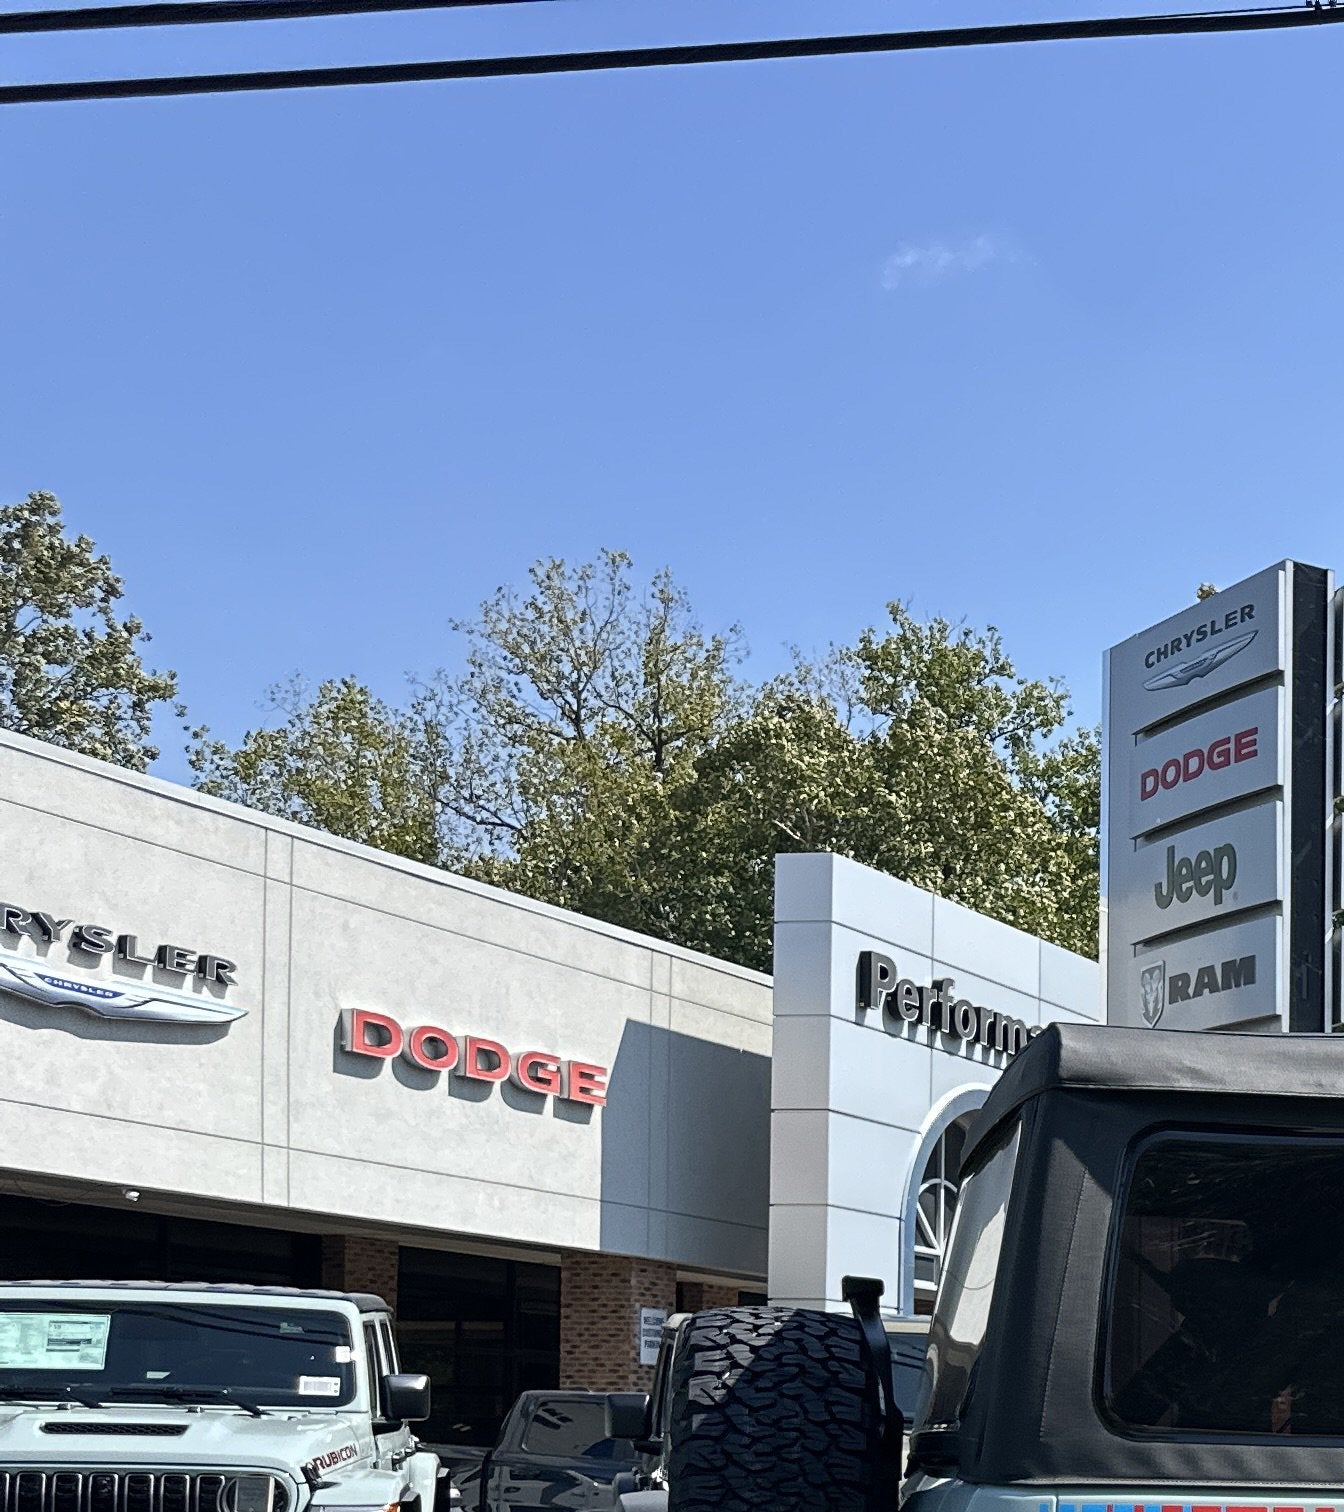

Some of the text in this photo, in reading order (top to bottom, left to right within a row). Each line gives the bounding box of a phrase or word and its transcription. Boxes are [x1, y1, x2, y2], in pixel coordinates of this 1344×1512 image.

[1144, 604, 1255, 669] CHRYSLER
[1140, 726, 1259, 801] DODGE
[1154, 843, 1237, 910] Jeep
[43, 976, 115, 998] CHRYSLER
[858, 951, 1044, 1056] Perform
[1168, 954, 1257, 1005] RAM
[338, 1008, 608, 1107] DODGE
[312, 1443, 358, 1471] RUBICON
